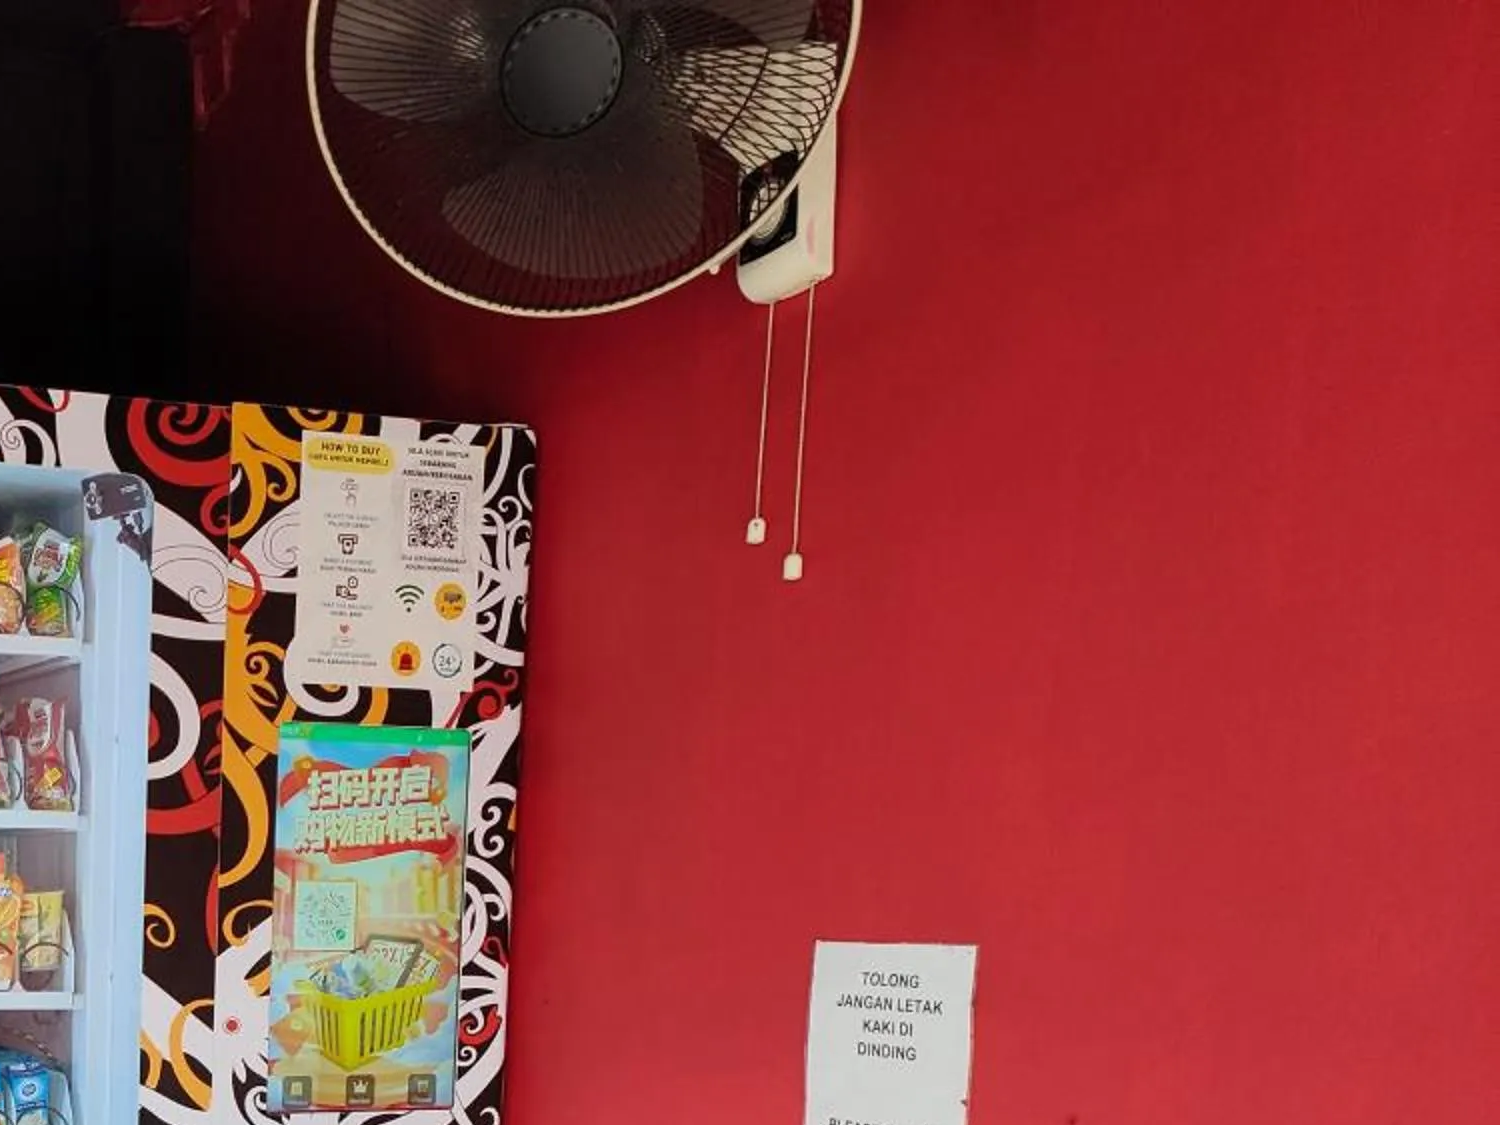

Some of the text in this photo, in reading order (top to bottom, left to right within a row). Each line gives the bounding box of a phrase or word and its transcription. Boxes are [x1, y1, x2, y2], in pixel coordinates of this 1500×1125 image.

[321, 440, 343, 453] HOW
[347, 443, 359, 454] TO
[308, 765, 431, 810] 扫码开启
[295, 803, 449, 854] 购物新模式
[861, 971, 920, 989] TOLONG
[836, 996, 943, 1015] JANGAN LETAK
[862, 1020, 913, 1037] KAKI DI
[857, 1042, 917, 1061] DINDING
